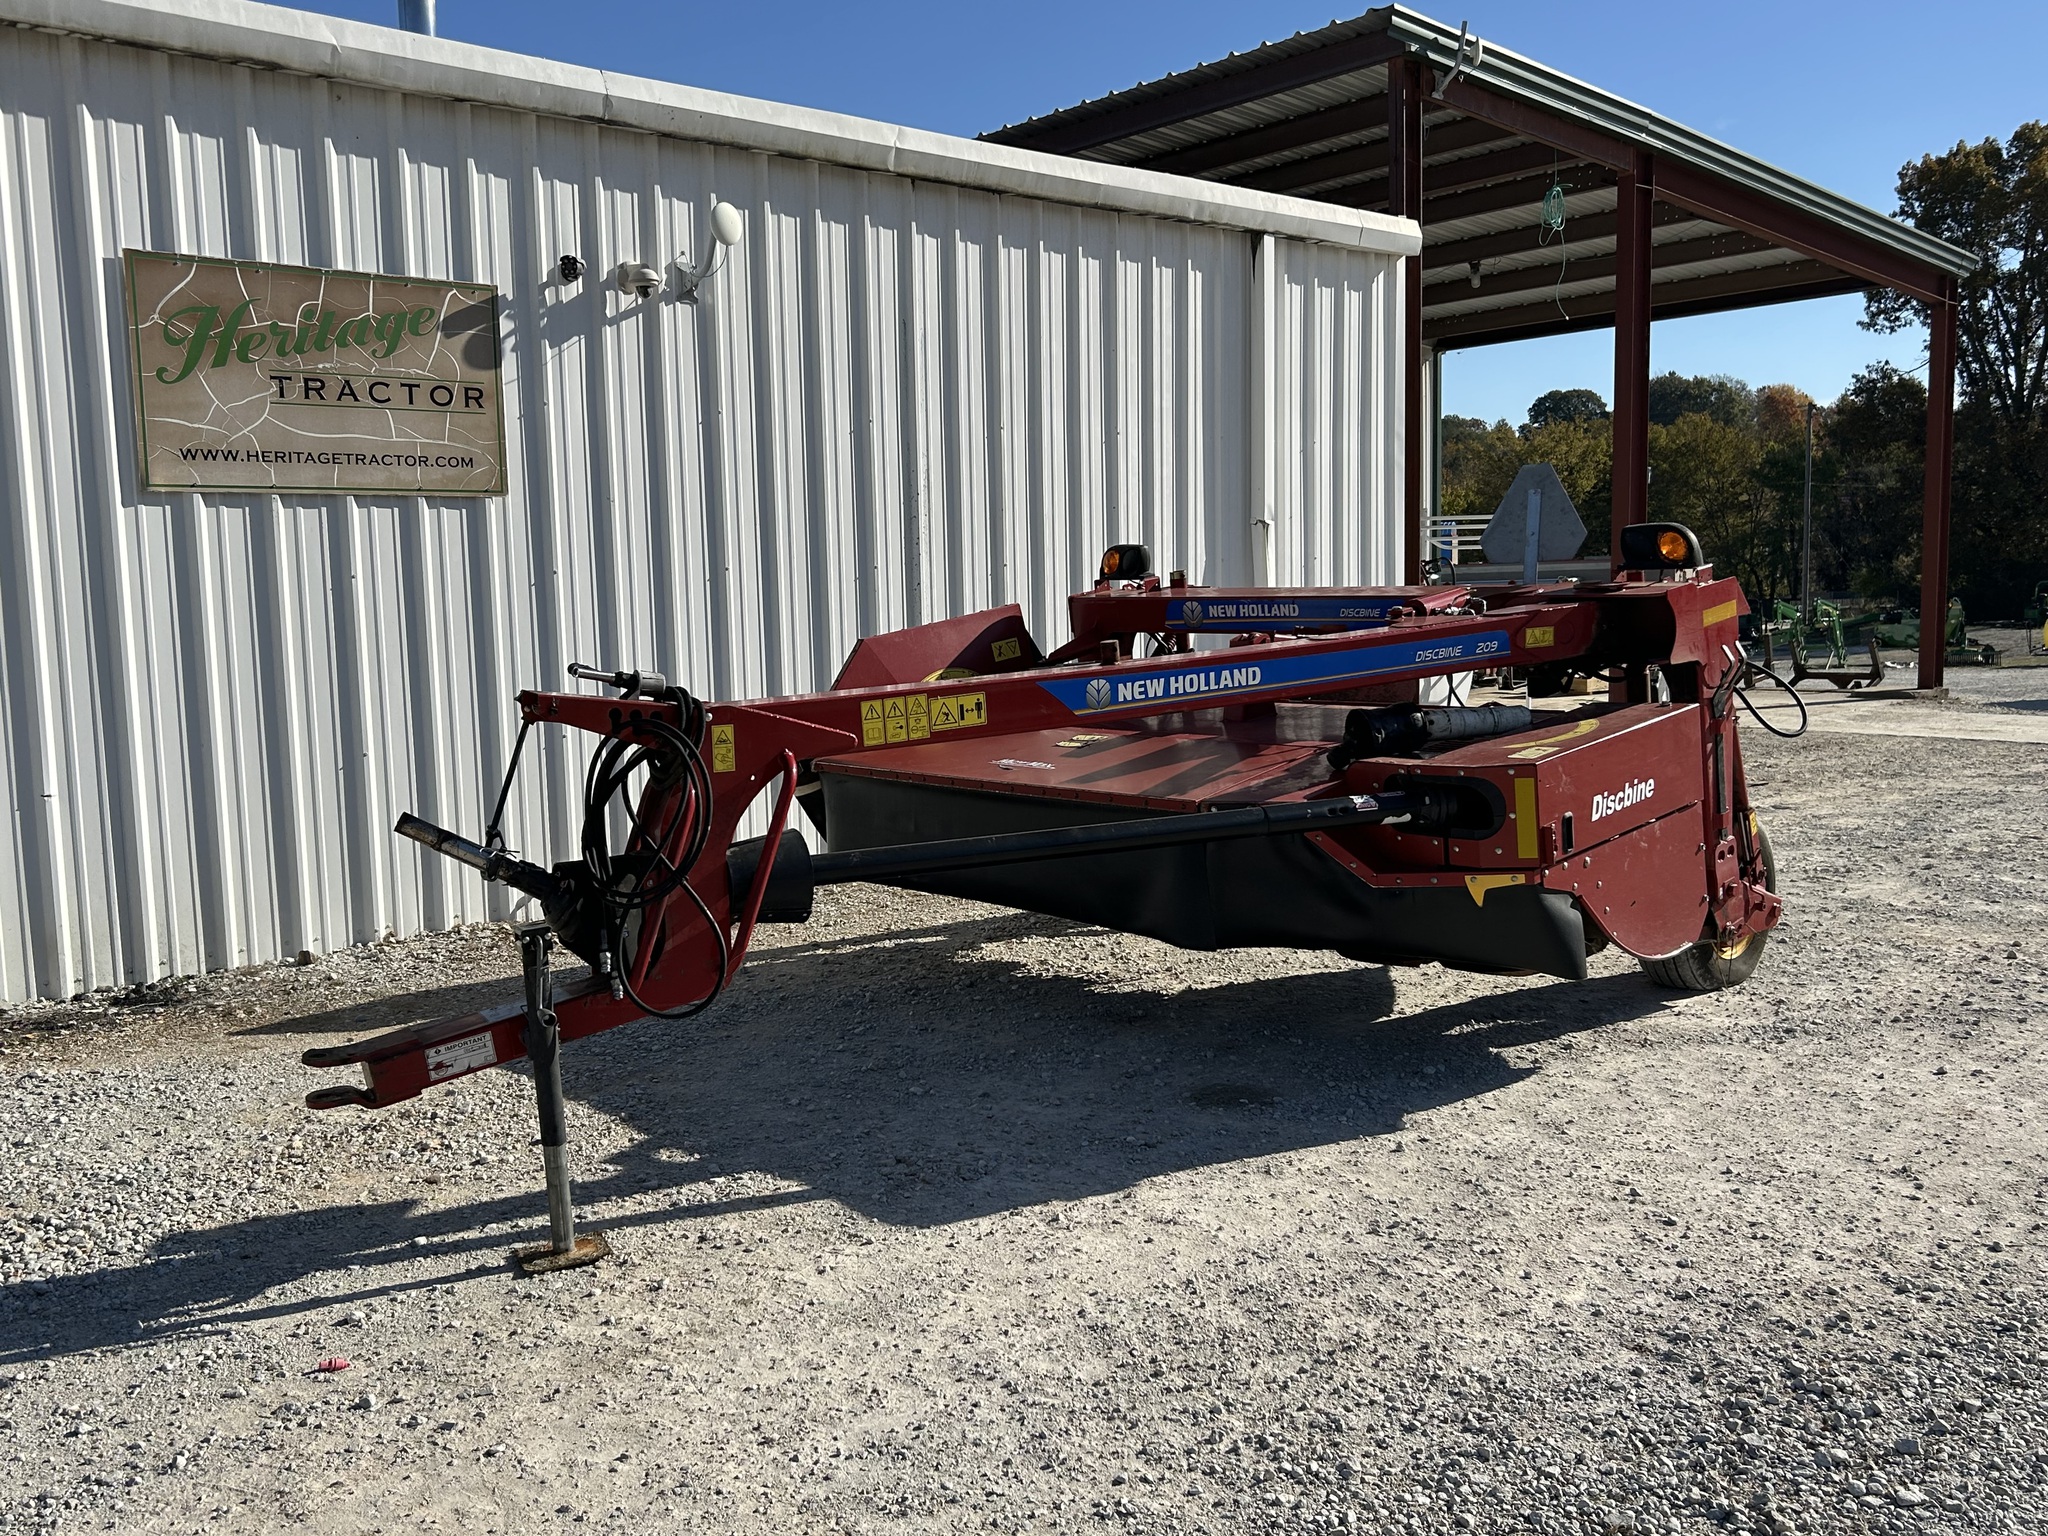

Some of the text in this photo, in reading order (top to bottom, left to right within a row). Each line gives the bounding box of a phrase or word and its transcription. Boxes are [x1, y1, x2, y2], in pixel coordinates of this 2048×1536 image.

[155, 297, 436, 384] Heritage
[269, 374, 485, 409] TRACTOR
[179, 447, 474, 469] WWW.HERITAGETRACTOR.COM
[1208, 604, 1299, 618] NEW HOLLAND
[1339, 608, 1381, 617] DISCBINE
[1415, 640, 1498, 662] DISCBINE 209
[1117, 666, 1262, 702] NEW HOLLAND
[1591, 778, 1655, 822] Discbine
[444, 1035, 487, 1052] IMPORTANT
